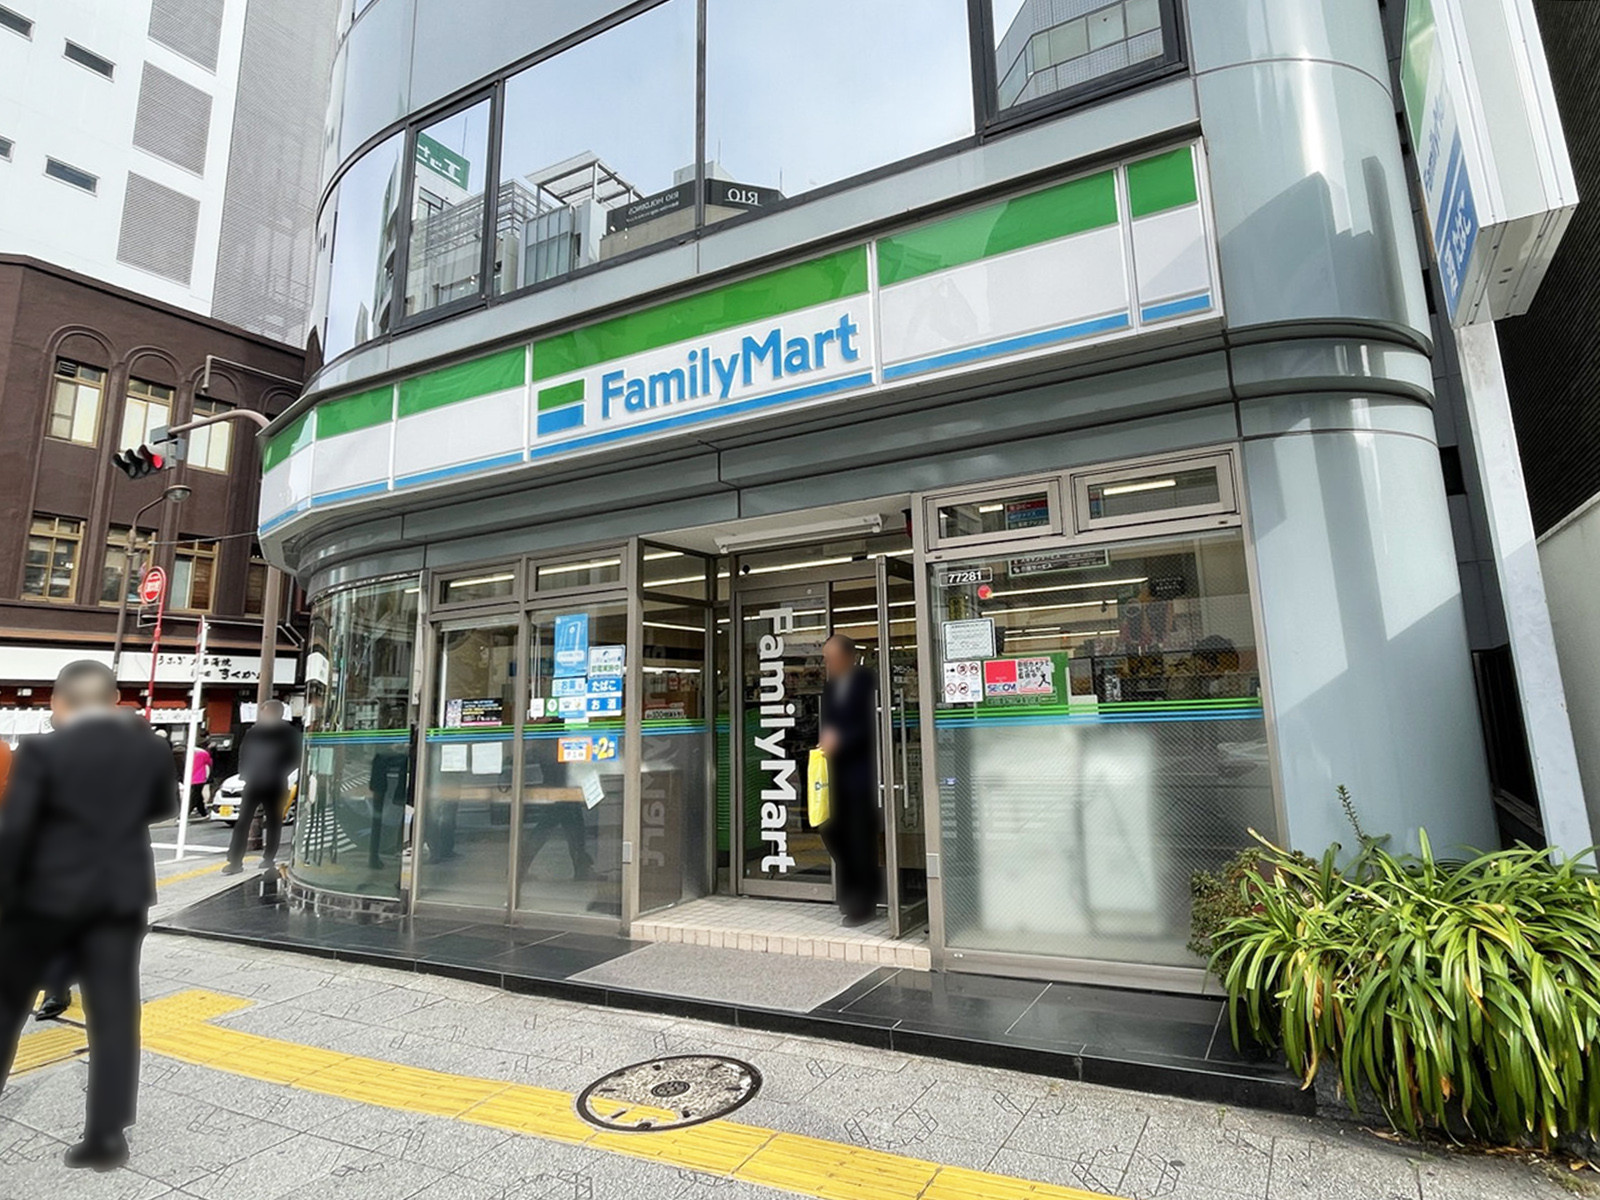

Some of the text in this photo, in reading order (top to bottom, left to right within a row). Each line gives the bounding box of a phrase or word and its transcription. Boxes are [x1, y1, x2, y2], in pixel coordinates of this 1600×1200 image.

[602, 312, 860, 420] FamilyMart
[948, 570, 983, 583] 77281
[591, 680, 617, 692] たばこ
[754, 607, 797, 874] FamilyMart
